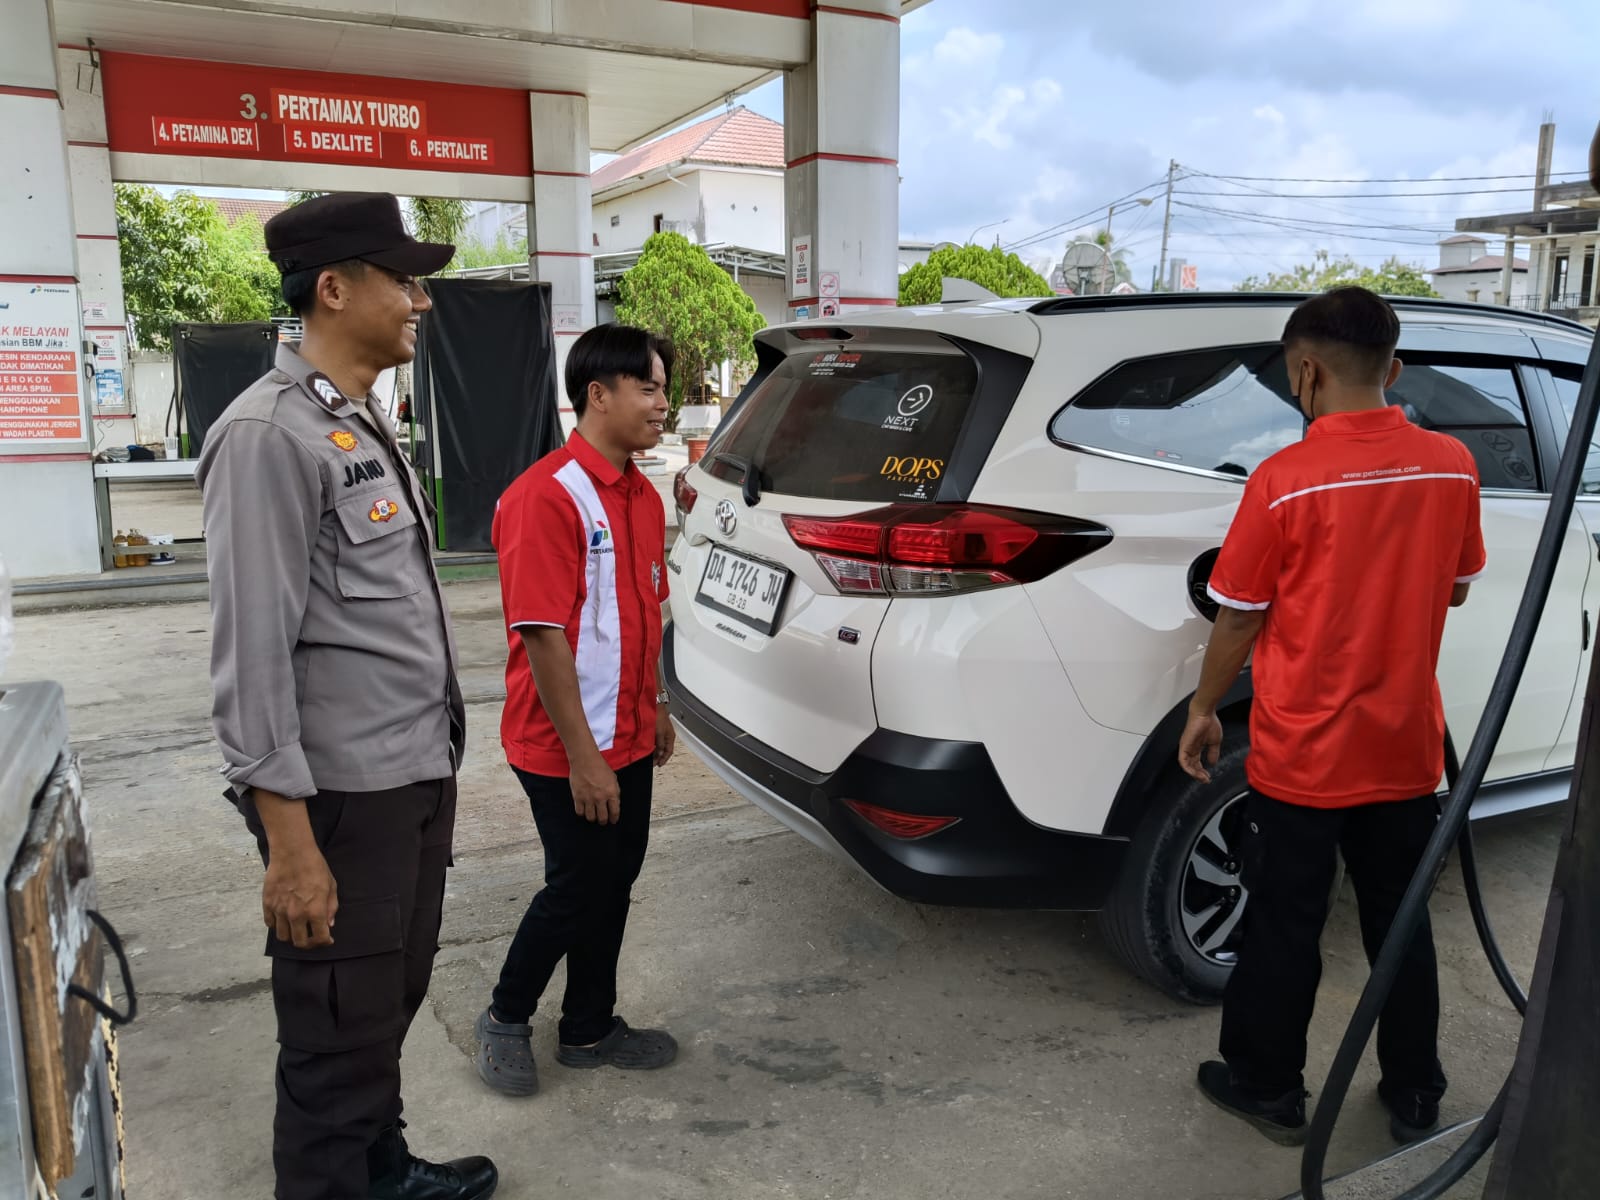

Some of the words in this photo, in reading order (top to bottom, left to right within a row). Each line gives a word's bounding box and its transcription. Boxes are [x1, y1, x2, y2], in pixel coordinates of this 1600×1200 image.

[240, 93, 268, 120] 3.
[278, 94, 364, 125] PERTAMAX
[367, 101, 420, 130] TURBO
[159, 122, 170, 141] 4.
[172, 123, 229, 144] PETAMINA
[231, 127, 253, 146] DEX
[293, 130, 307, 148] 5.
[311, 131, 374, 153] DEXLITE
[410, 139, 422, 156] 6.
[427, 140, 488, 160] PERTALITE
[13, 326, 69, 337] MELAYANI
[22, 338, 43, 347] BBM
[45, 339, 63, 347] Jika
[21, 362, 65, 370] DIMATIKAN
[884, 416, 919, 427] NEXT
[28, 430, 55, 438] PLASTIK
[344, 458, 385, 488] JANU
[880, 456, 944, 480] DOPS
[1341, 466, 1421, 479] www.pertamina.com
[707, 552, 726, 584] DA
[725, 560, 760, 597] 1746
[762, 573, 782, 607] JW
